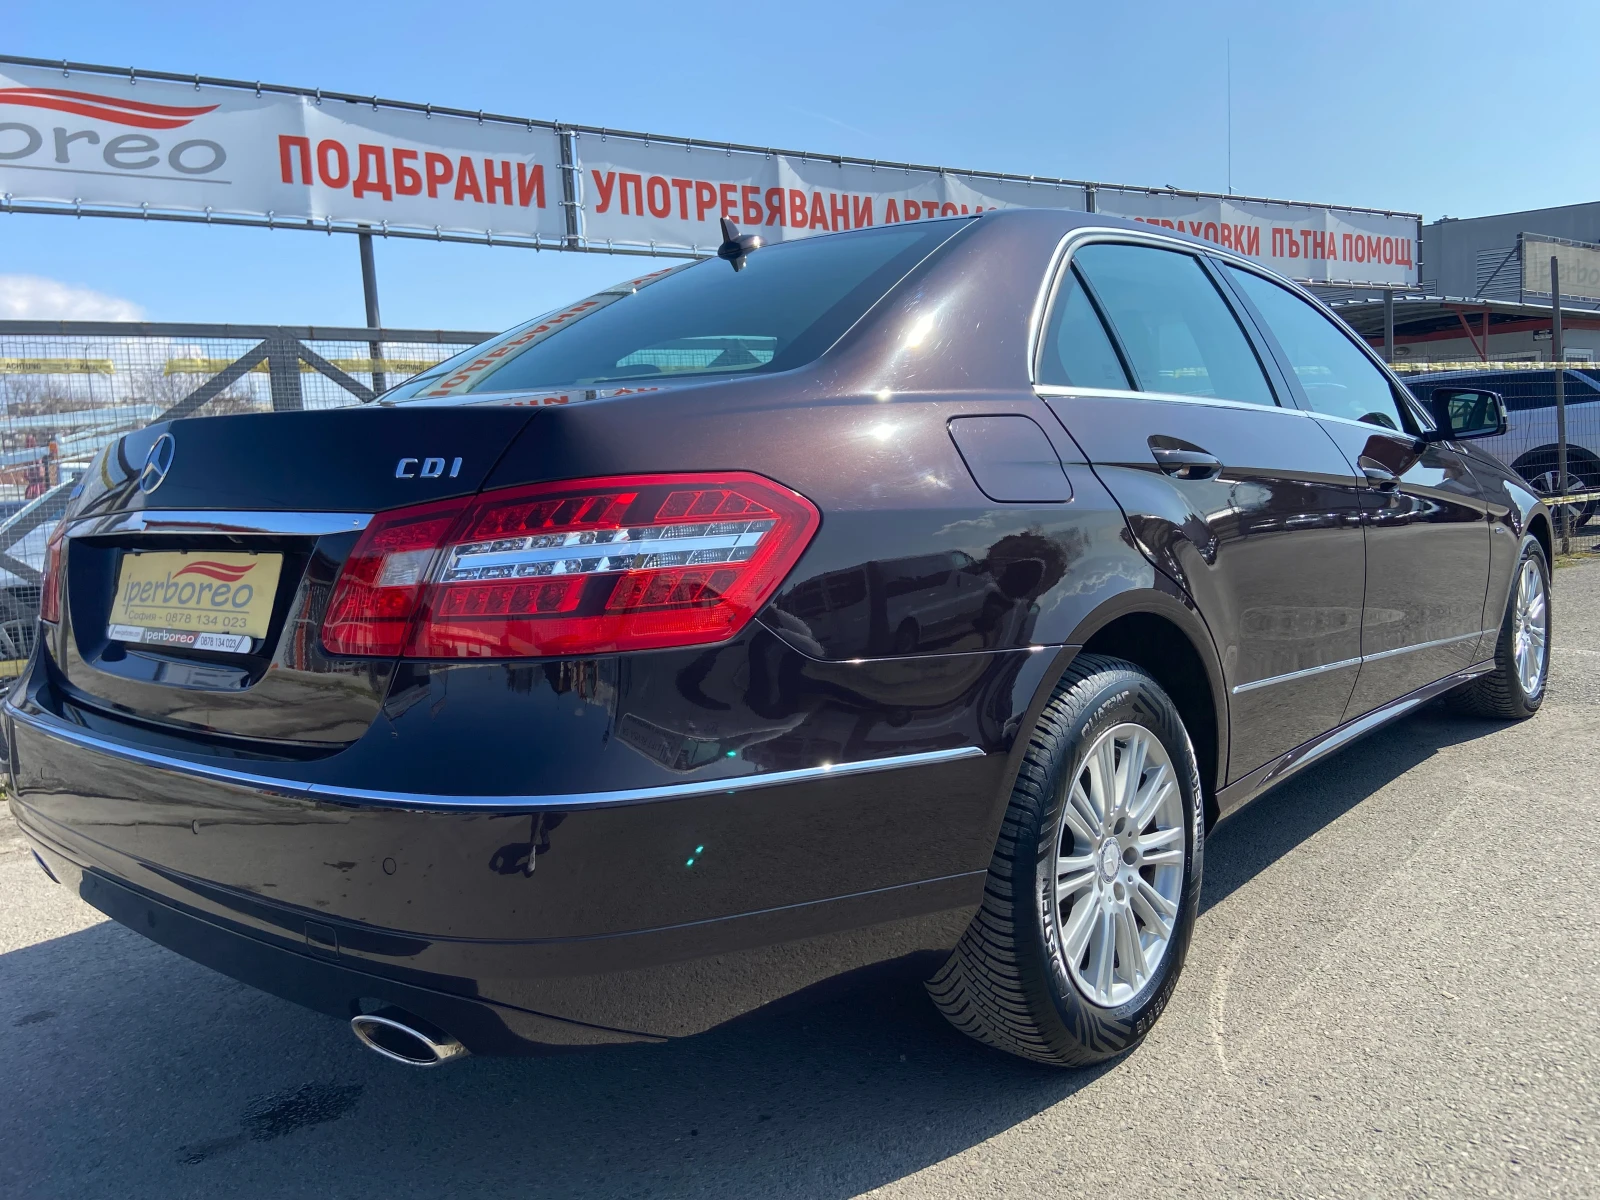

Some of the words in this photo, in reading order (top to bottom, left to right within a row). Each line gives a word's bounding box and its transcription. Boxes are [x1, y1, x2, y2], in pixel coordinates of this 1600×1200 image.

[279, 134, 546, 209] ПОДБРАНИ
[591, 170, 874, 231] УПОТРЕБЯВАНИ
[1272, 227, 1338, 261] ПЪТНА
[1342, 233, 1413, 271] ПОМОЩ
[395, 457, 463, 479] CDI
[123, 572, 254, 615] iperboreo
[128, 610, 157, 622] София
[165, 612, 192, 624] 0878
[196, 614, 218, 626] 134
[223, 616, 248, 629] 023
[144, 628, 195, 644] iperboreo
[200, 635, 214, 647] 0878
[215, 637, 225, 648] 134
[225, 638, 237, 649] 023
